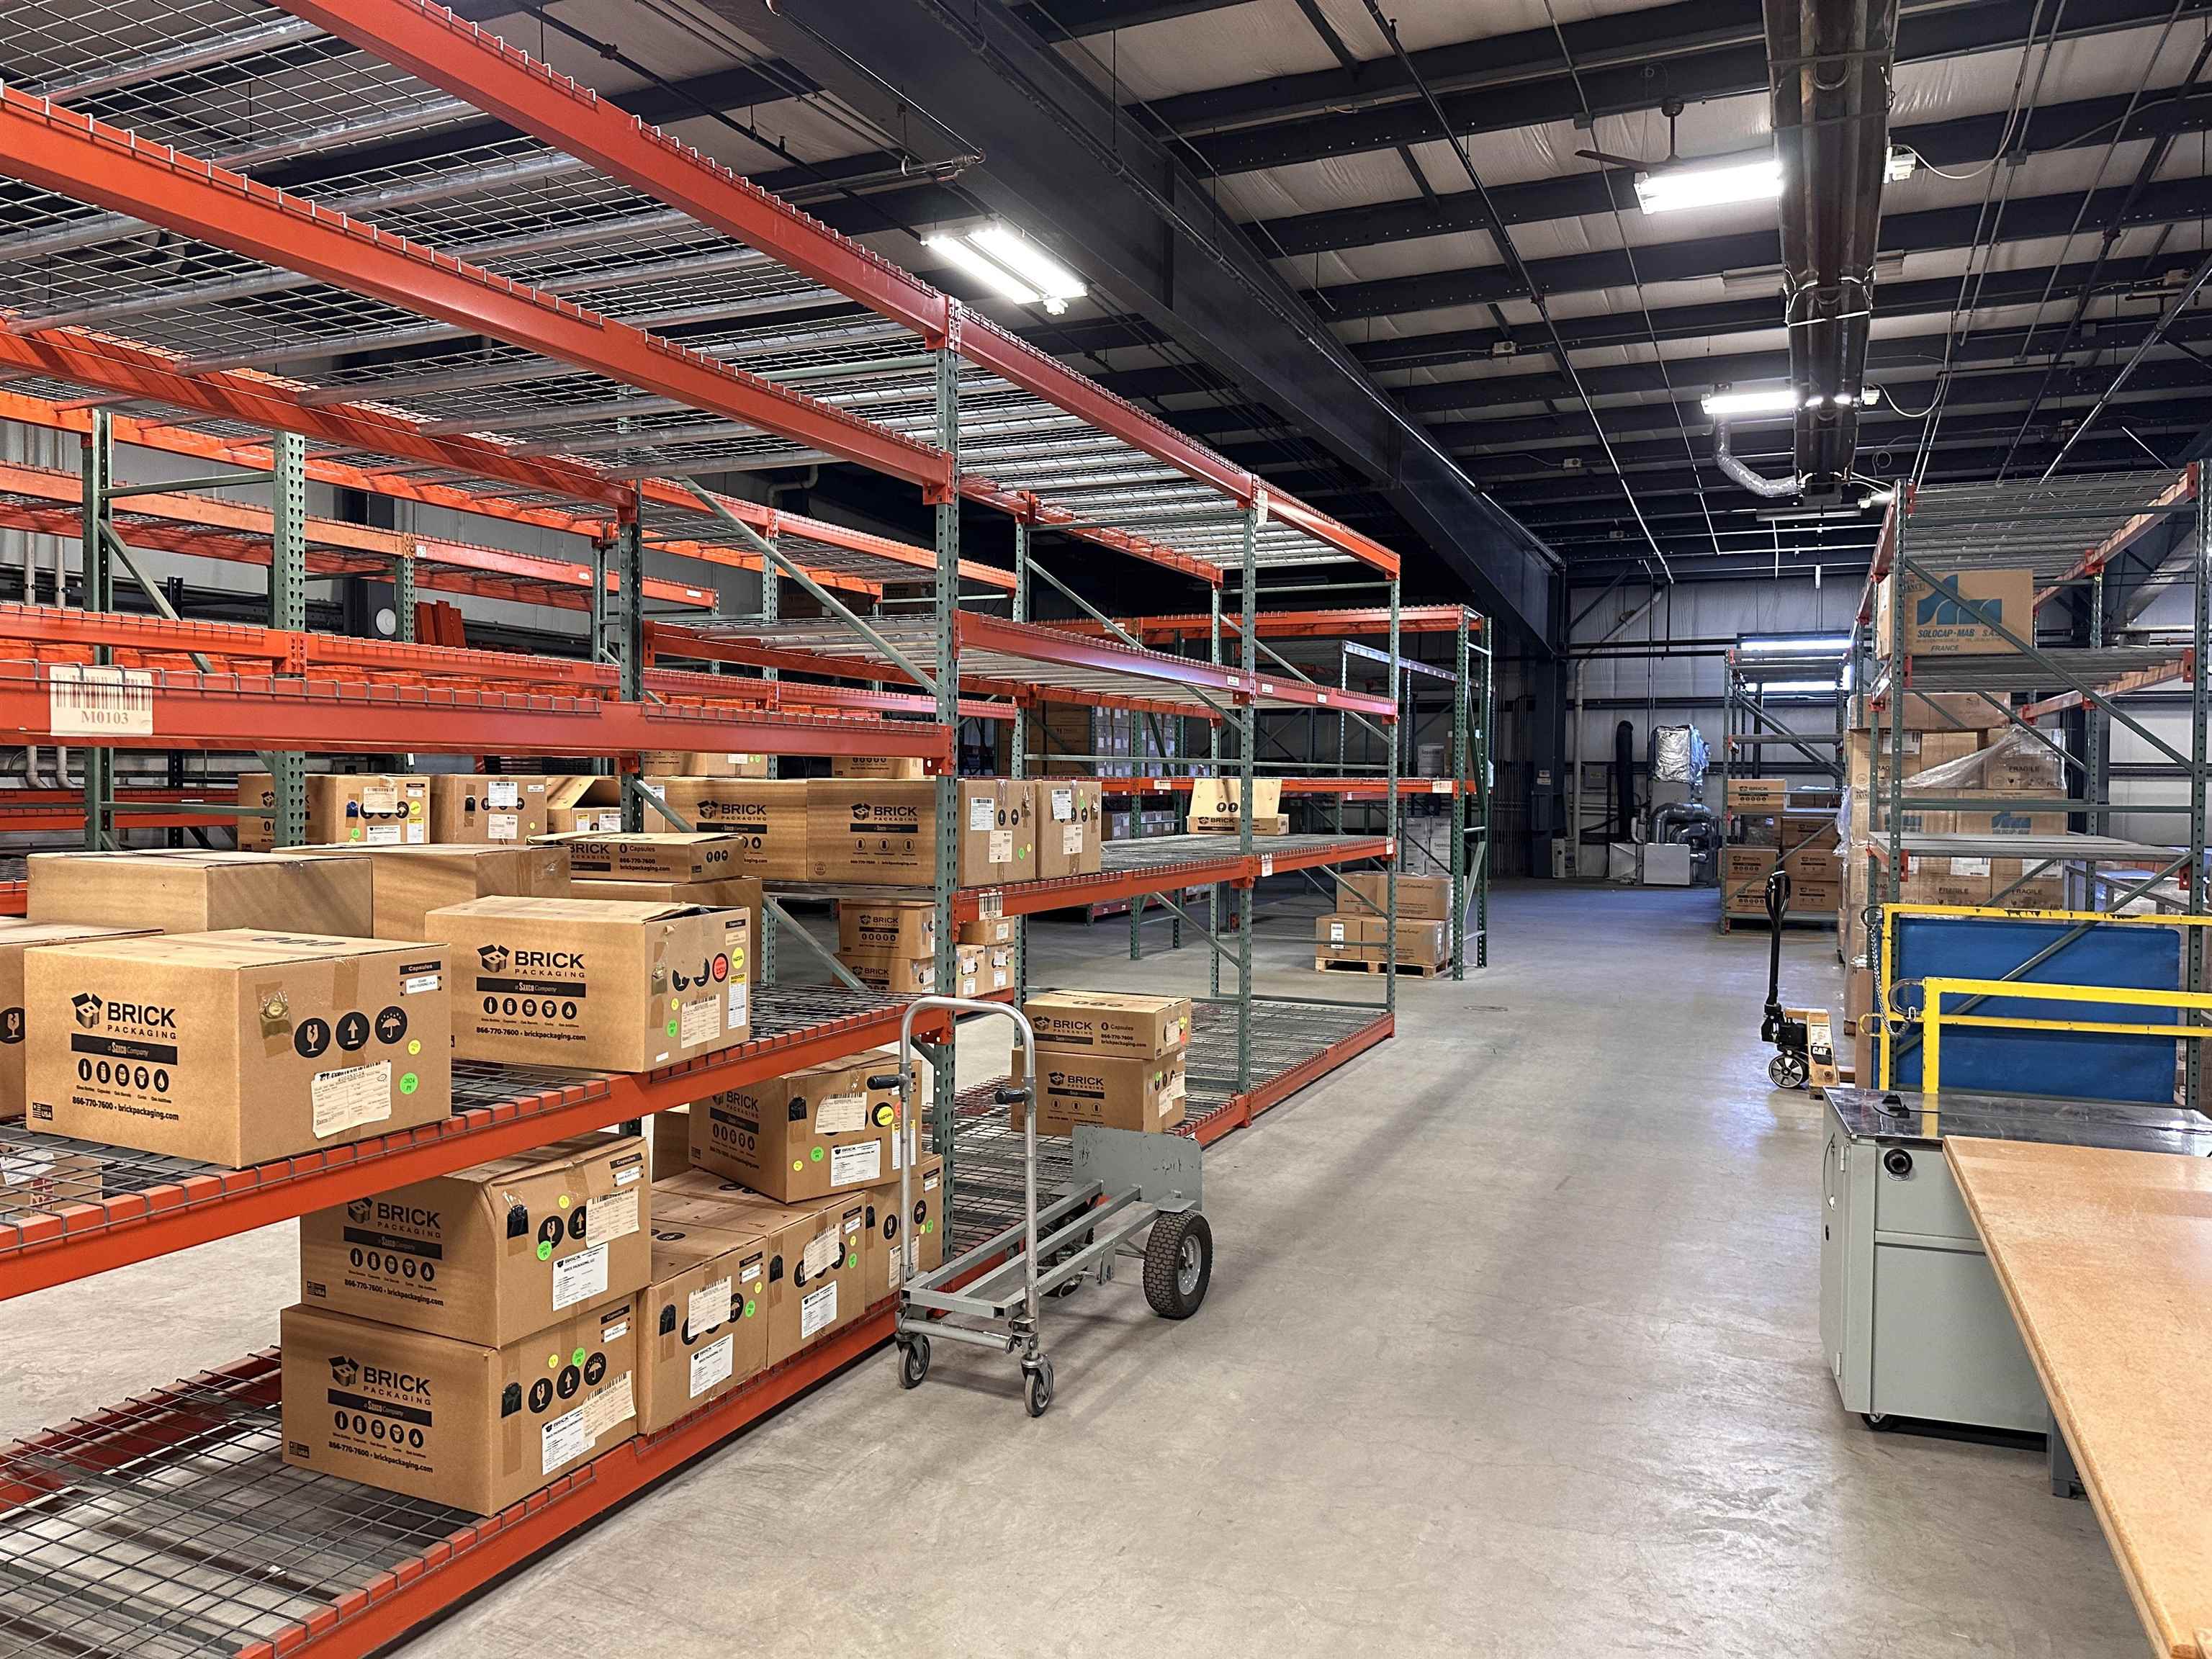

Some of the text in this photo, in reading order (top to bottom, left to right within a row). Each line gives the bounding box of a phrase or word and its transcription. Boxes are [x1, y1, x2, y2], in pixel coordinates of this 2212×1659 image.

[81, 711, 129, 724] M0103
[721, 804, 767, 815] BRICK
[874, 806, 918, 816] BRICK
[515, 950, 585, 969] BRICK
[514, 968, 585, 979] PACKAGING
[107, 1002, 177, 1029] BRICK
[107, 1025, 177, 1039] PACKAGING
[1053, 1020, 1092, 1030] BRICK
[476, 1026, 586, 1041] 866-770-7600 brickpackaging.com
[1812, 1046, 1828, 1055] CAT
[1067, 1075, 1104, 1086] BRICK
[72, 1096, 179, 1120] 866-770-7600 brickpackaging.com
[727, 1091, 759, 1112] BRICK
[616, 1156, 637, 1166] Capsules
[377, 1202, 441, 1230] BRICK
[377, 1221, 441, 1238] PACKAGING
[387, 1287, 444, 1307] brickpackaging.com
[364, 1366, 431, 1397] BRICK
[364, 1385, 431, 1406] PACKAGING
[374, 1452, 433, 1474] brickpackaging.com
